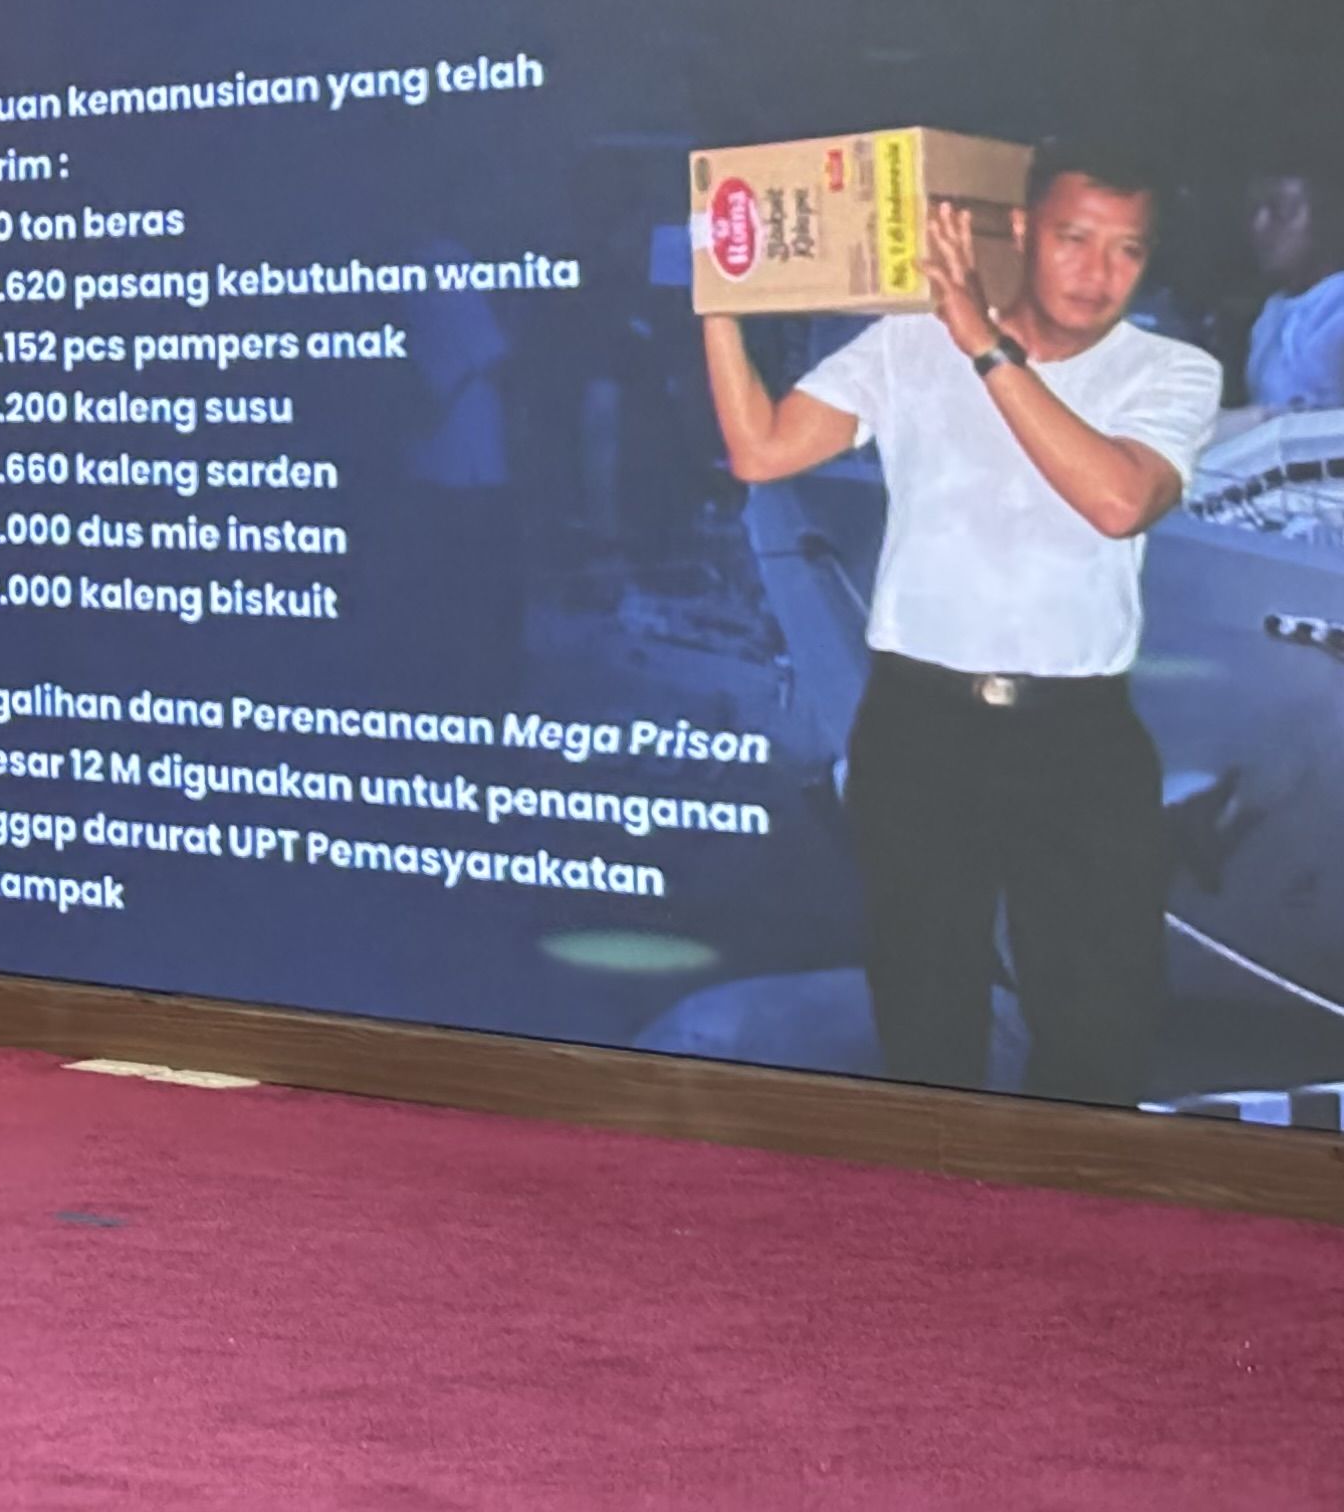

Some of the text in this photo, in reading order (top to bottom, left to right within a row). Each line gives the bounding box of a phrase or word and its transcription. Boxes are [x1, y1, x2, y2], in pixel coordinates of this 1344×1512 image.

[69, 72, 319, 116] kemanusiaan
[327, 68, 428, 110] yang
[437, 53, 543, 92] telah
[20, 212, 76, 240] ton
[84, 207, 184, 237] beras
[75, 272, 208, 309] pasang
[218, 259, 426, 296] kebutuhan
[435, 252, 579, 290] wanita
[64, 336, 125, 371] pcs
[134, 333, 299, 370] pampers
[307, 324, 406, 358] anak
[75, 391, 196, 433] kaleng
[206, 398, 292, 423] susu
[76, 453, 198, 496] kaleng
[207, 455, 337, 488] sarden
[77, 515, 143, 548] dus
[152, 515, 220, 550] mie
[228, 516, 346, 553] instan
[81, 577, 202, 622] kaleng
[210, 580, 337, 618] biskuit
[129, 690, 223, 728] dana
[233, 698, 493, 744] Perencanaan
[503, 713, 620, 762] Mega
[629, 720, 769, 763] Prison
[70, 749, 104, 781] 12
[111, 752, 140, 784] M
[148, 754, 352, 801] digunakan
[361, 775, 479, 811] untuk
[487, 786, 769, 836] penanganan
[84, 813, 222, 855] darurat
[229, 825, 299, 861] UPT
[308, 832, 664, 896] Pemasyarakatan
